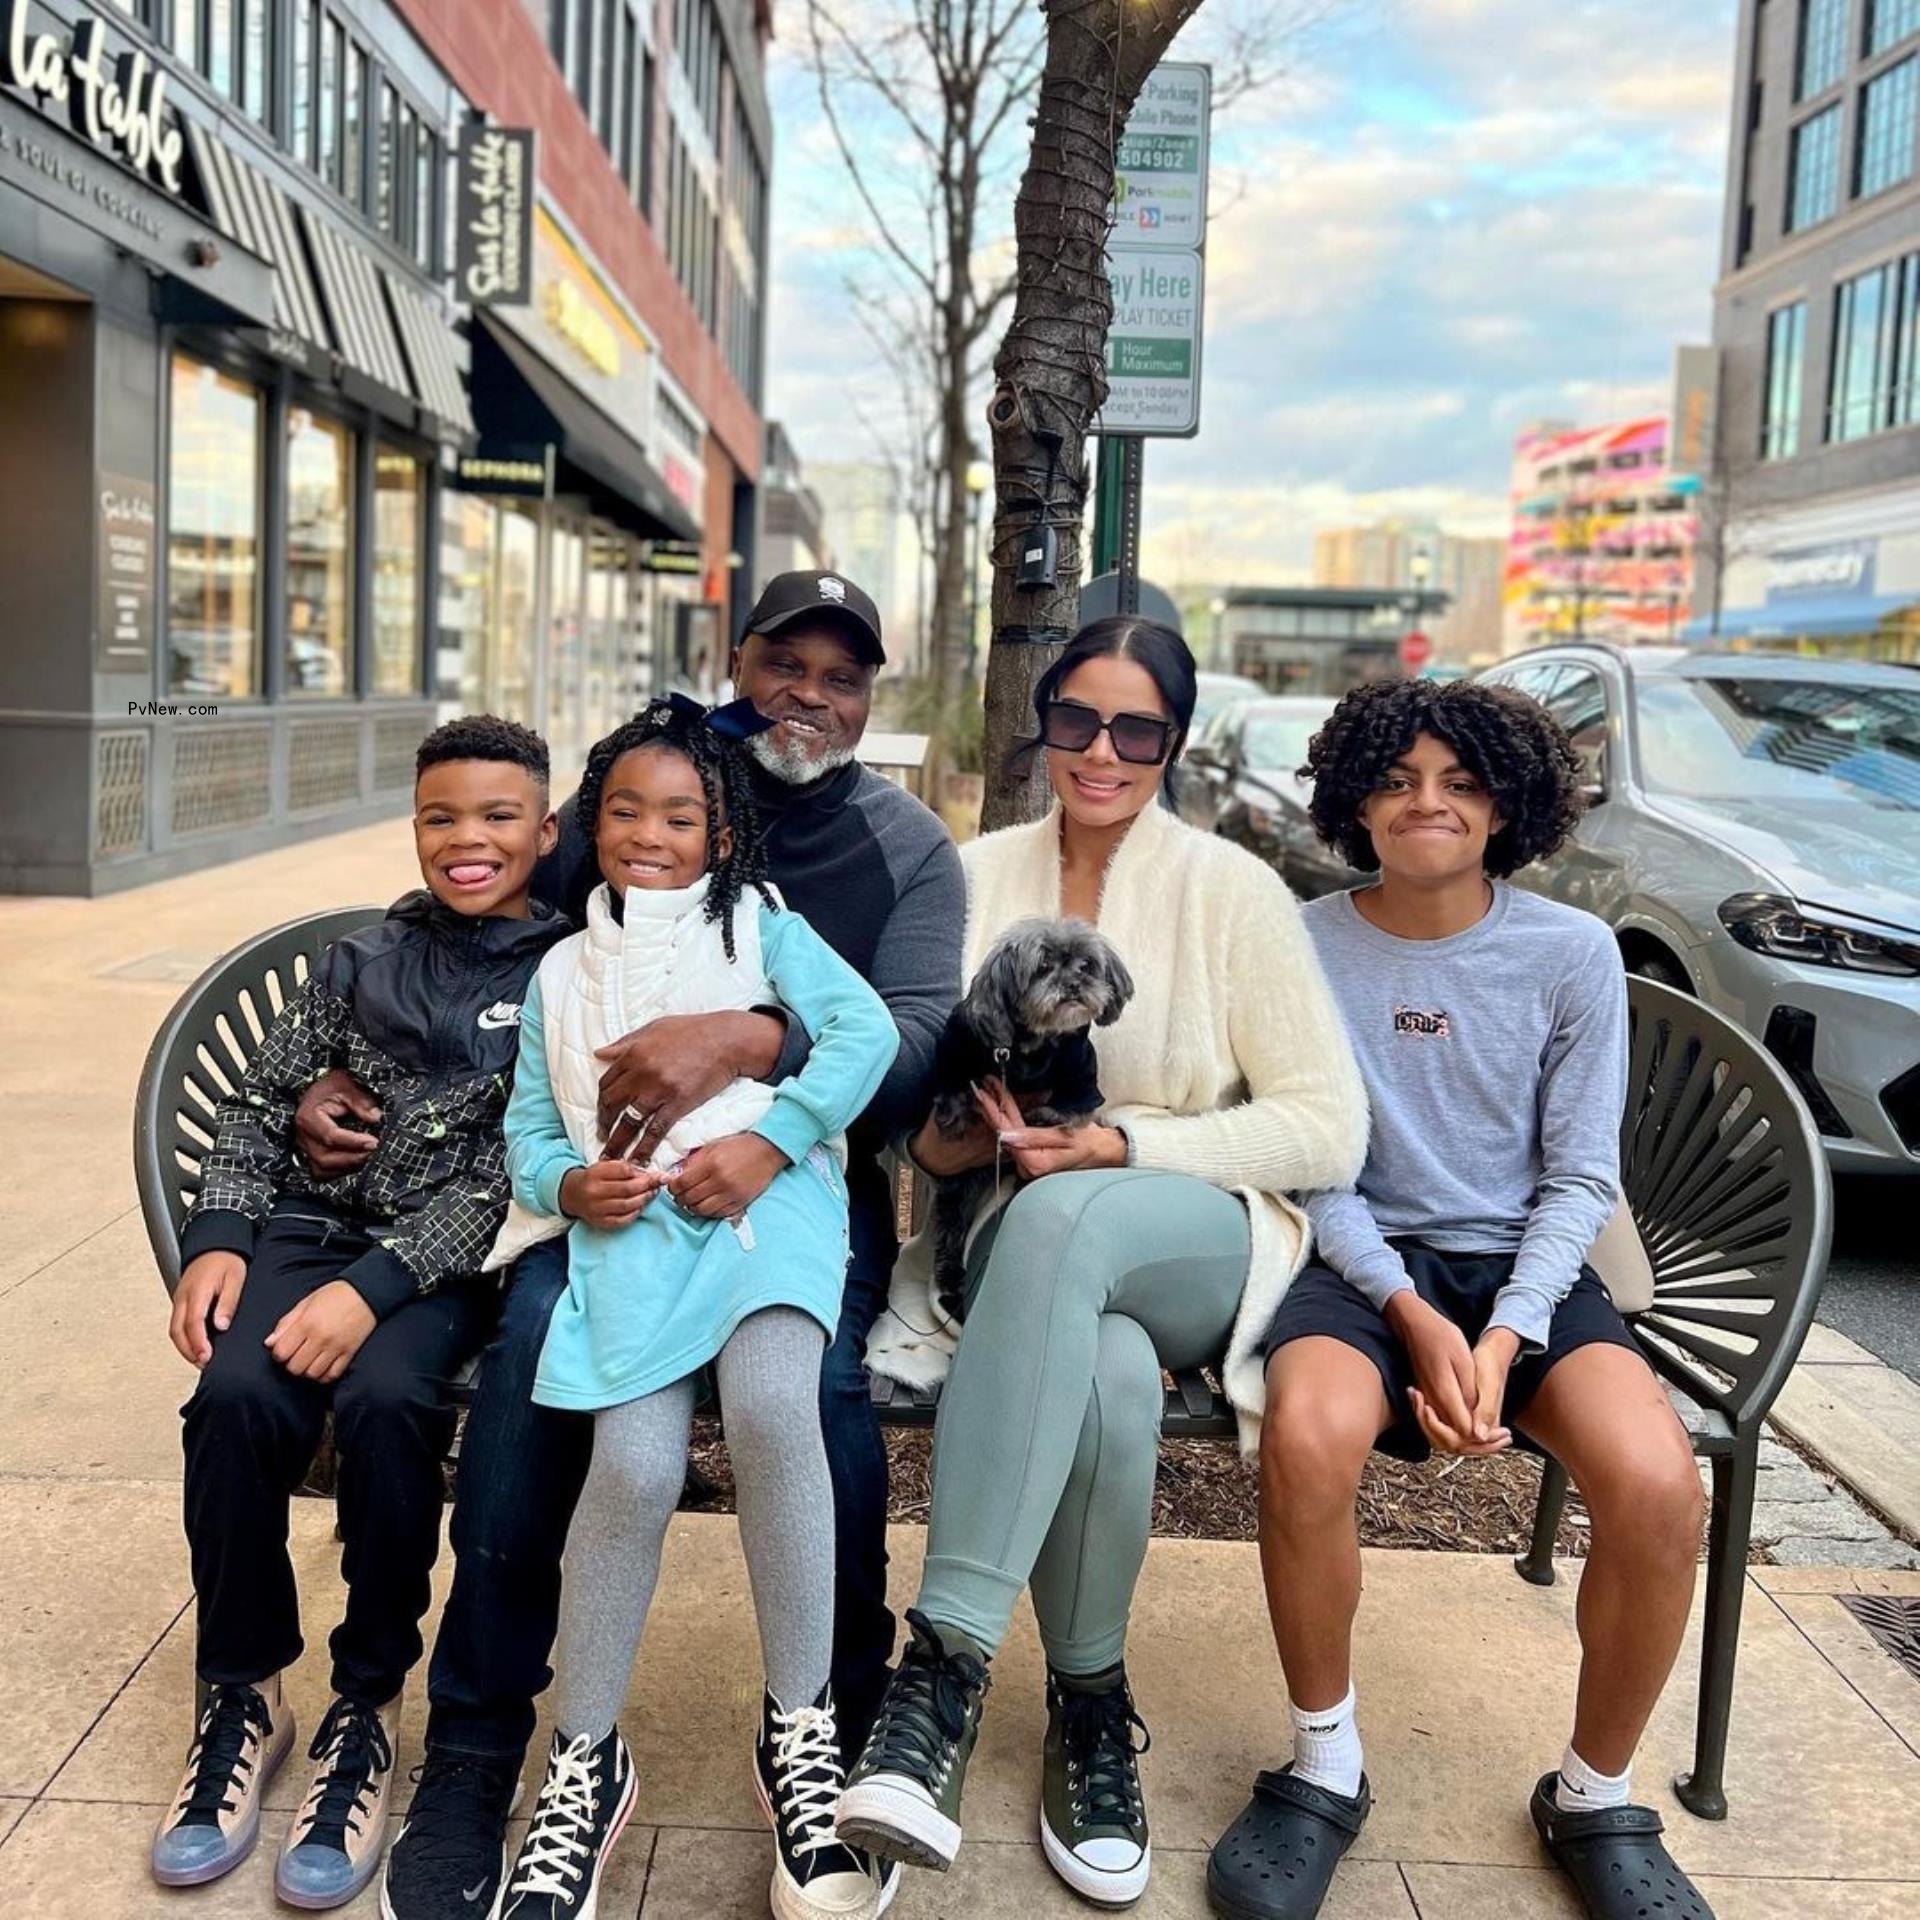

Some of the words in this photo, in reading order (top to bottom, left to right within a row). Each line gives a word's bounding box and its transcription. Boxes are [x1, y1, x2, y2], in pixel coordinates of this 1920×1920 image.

[71, 16, 183, 193] table
[1148, 82, 1199, 107] Parking
[1160, 110, 1197, 126] Phone
[469, 131, 506, 204] table
[1120, 148, 1184, 169] 504902
[469, 204, 502, 239] la
[466, 240, 502, 297] Sur
[1111, 273, 1134, 304] ay
[1140, 266, 1191, 298] Here
[1113, 306, 1145, 325] PLAY
[1146, 307, 1193, 328] TICKET
[1122, 342, 1153, 357] Hour
[1121, 356, 1183, 372] Maximum
[461, 459, 544, 483] SEPHORA
